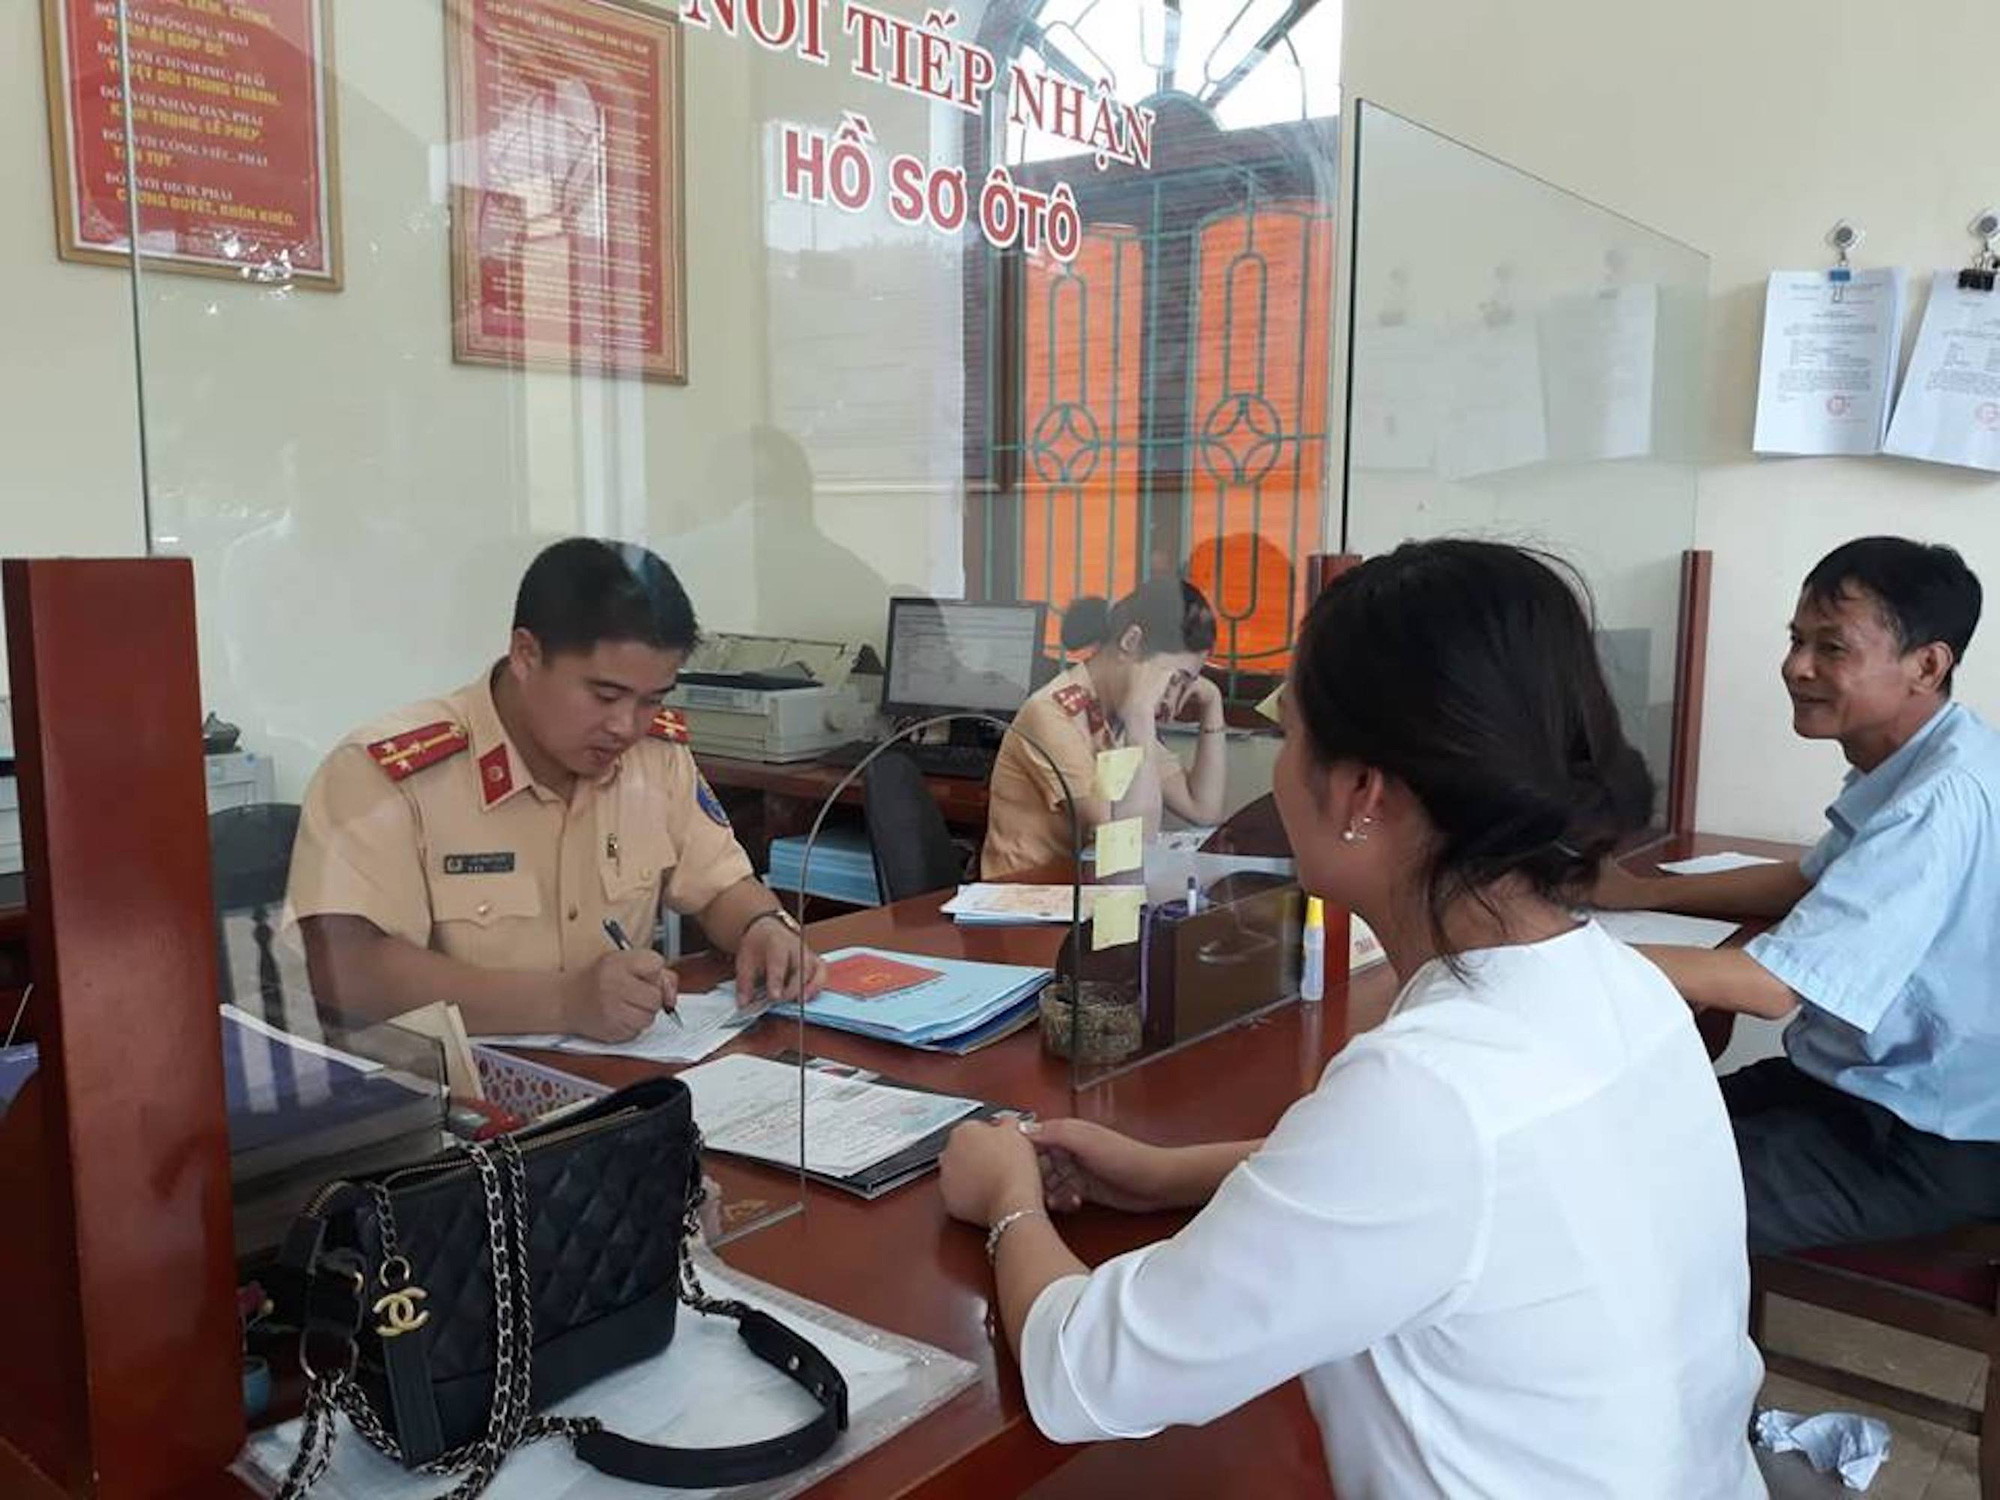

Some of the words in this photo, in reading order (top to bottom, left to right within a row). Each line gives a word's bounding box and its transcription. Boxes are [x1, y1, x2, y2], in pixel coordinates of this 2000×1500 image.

[846, 4, 995, 111] TIẾP
[1009, 65, 1155, 168] NHẬN
[784, 113, 872, 209] HỒ
[890, 155, 967, 231] SƠ
[981, 168, 1081, 259] ÔTÔ
